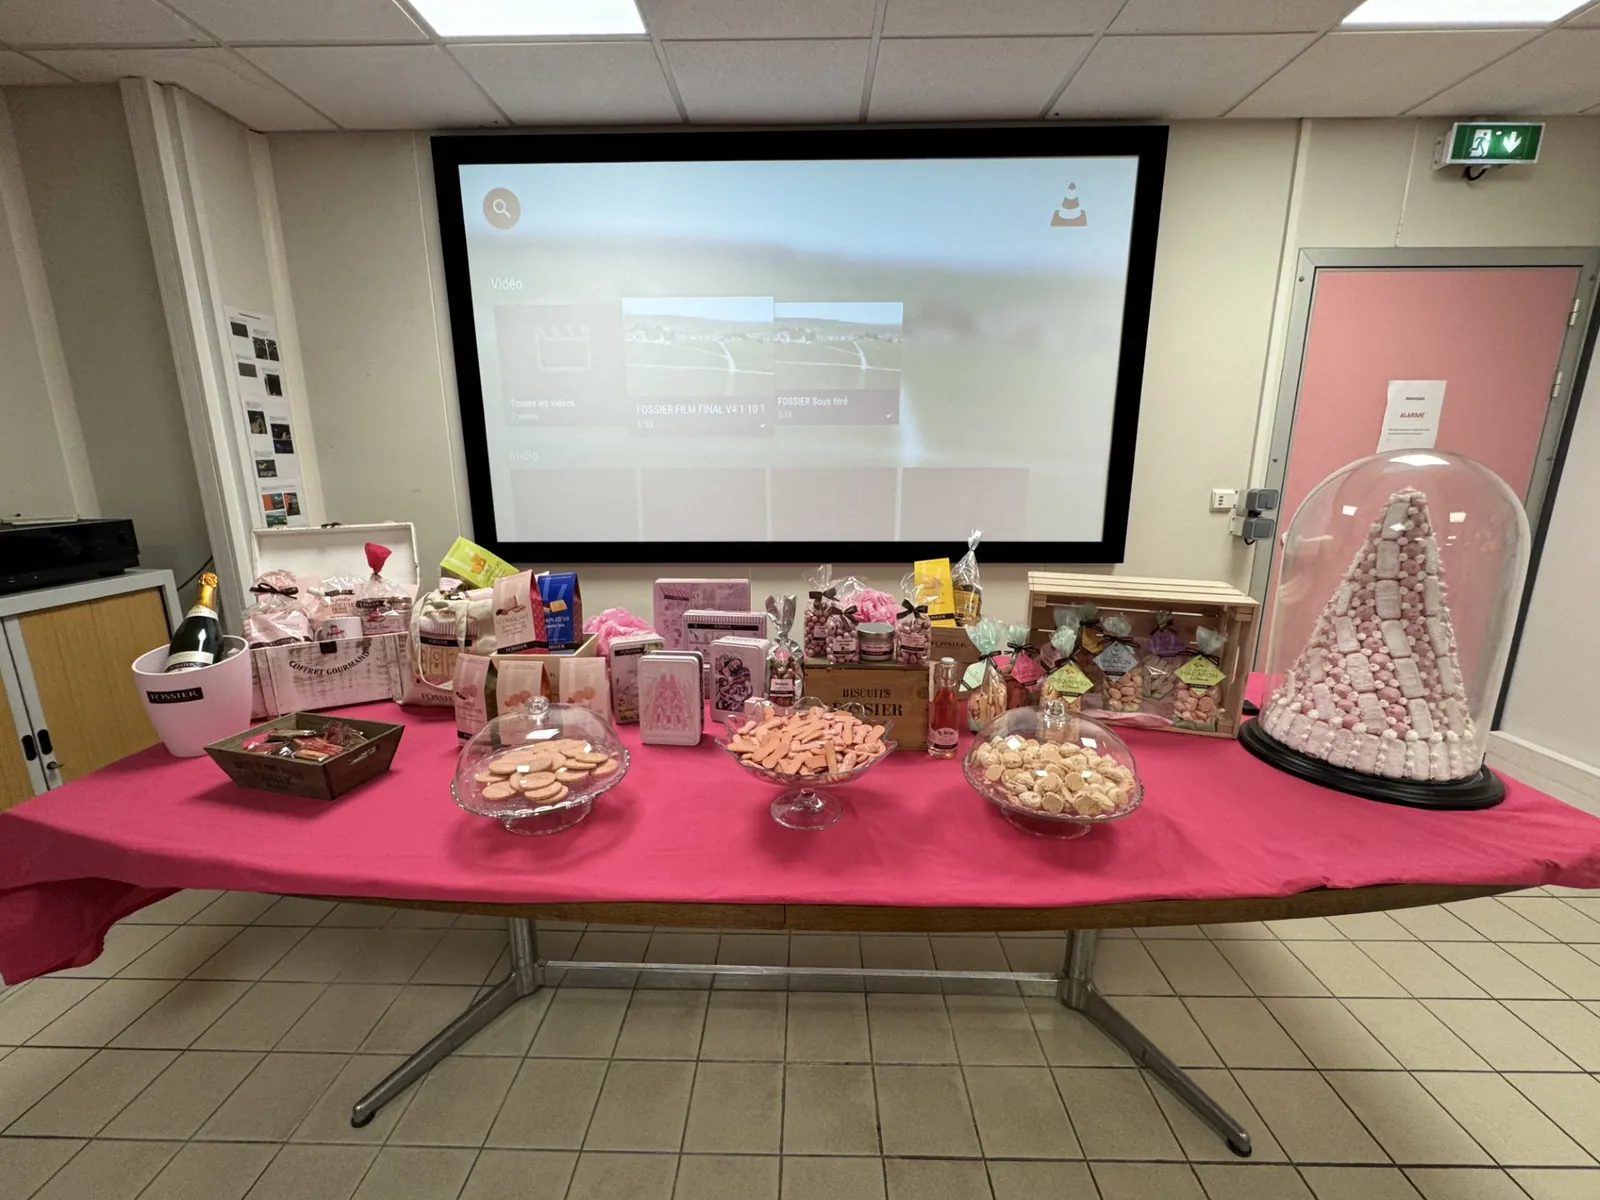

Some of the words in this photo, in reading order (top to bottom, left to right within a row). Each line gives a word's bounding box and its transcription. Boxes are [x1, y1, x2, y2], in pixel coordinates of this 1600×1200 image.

[491, 276, 523, 290] Vidéo
[510, 399, 537, 408] Toutes
[550, 397, 575, 408] vidéos
[777, 397, 811, 406] FOSSIER
[812, 397, 831, 406] Sous
[636, 404, 674, 415] FOSSIER
[675, 404, 697, 414] FILM
[698, 404, 723, 414] FINAL
[725, 404, 738, 414] V4
[747, 404, 758, 414] 10
[508, 450, 539, 462] Audio
[289, 660, 325, 675] COFFRET
[326, 651, 370, 675] GOURMAND
[1180, 670, 1219, 679] MACARON
[150, 690, 200, 701] FOSSIER
[842, 688, 892, 699] BISCUITS
